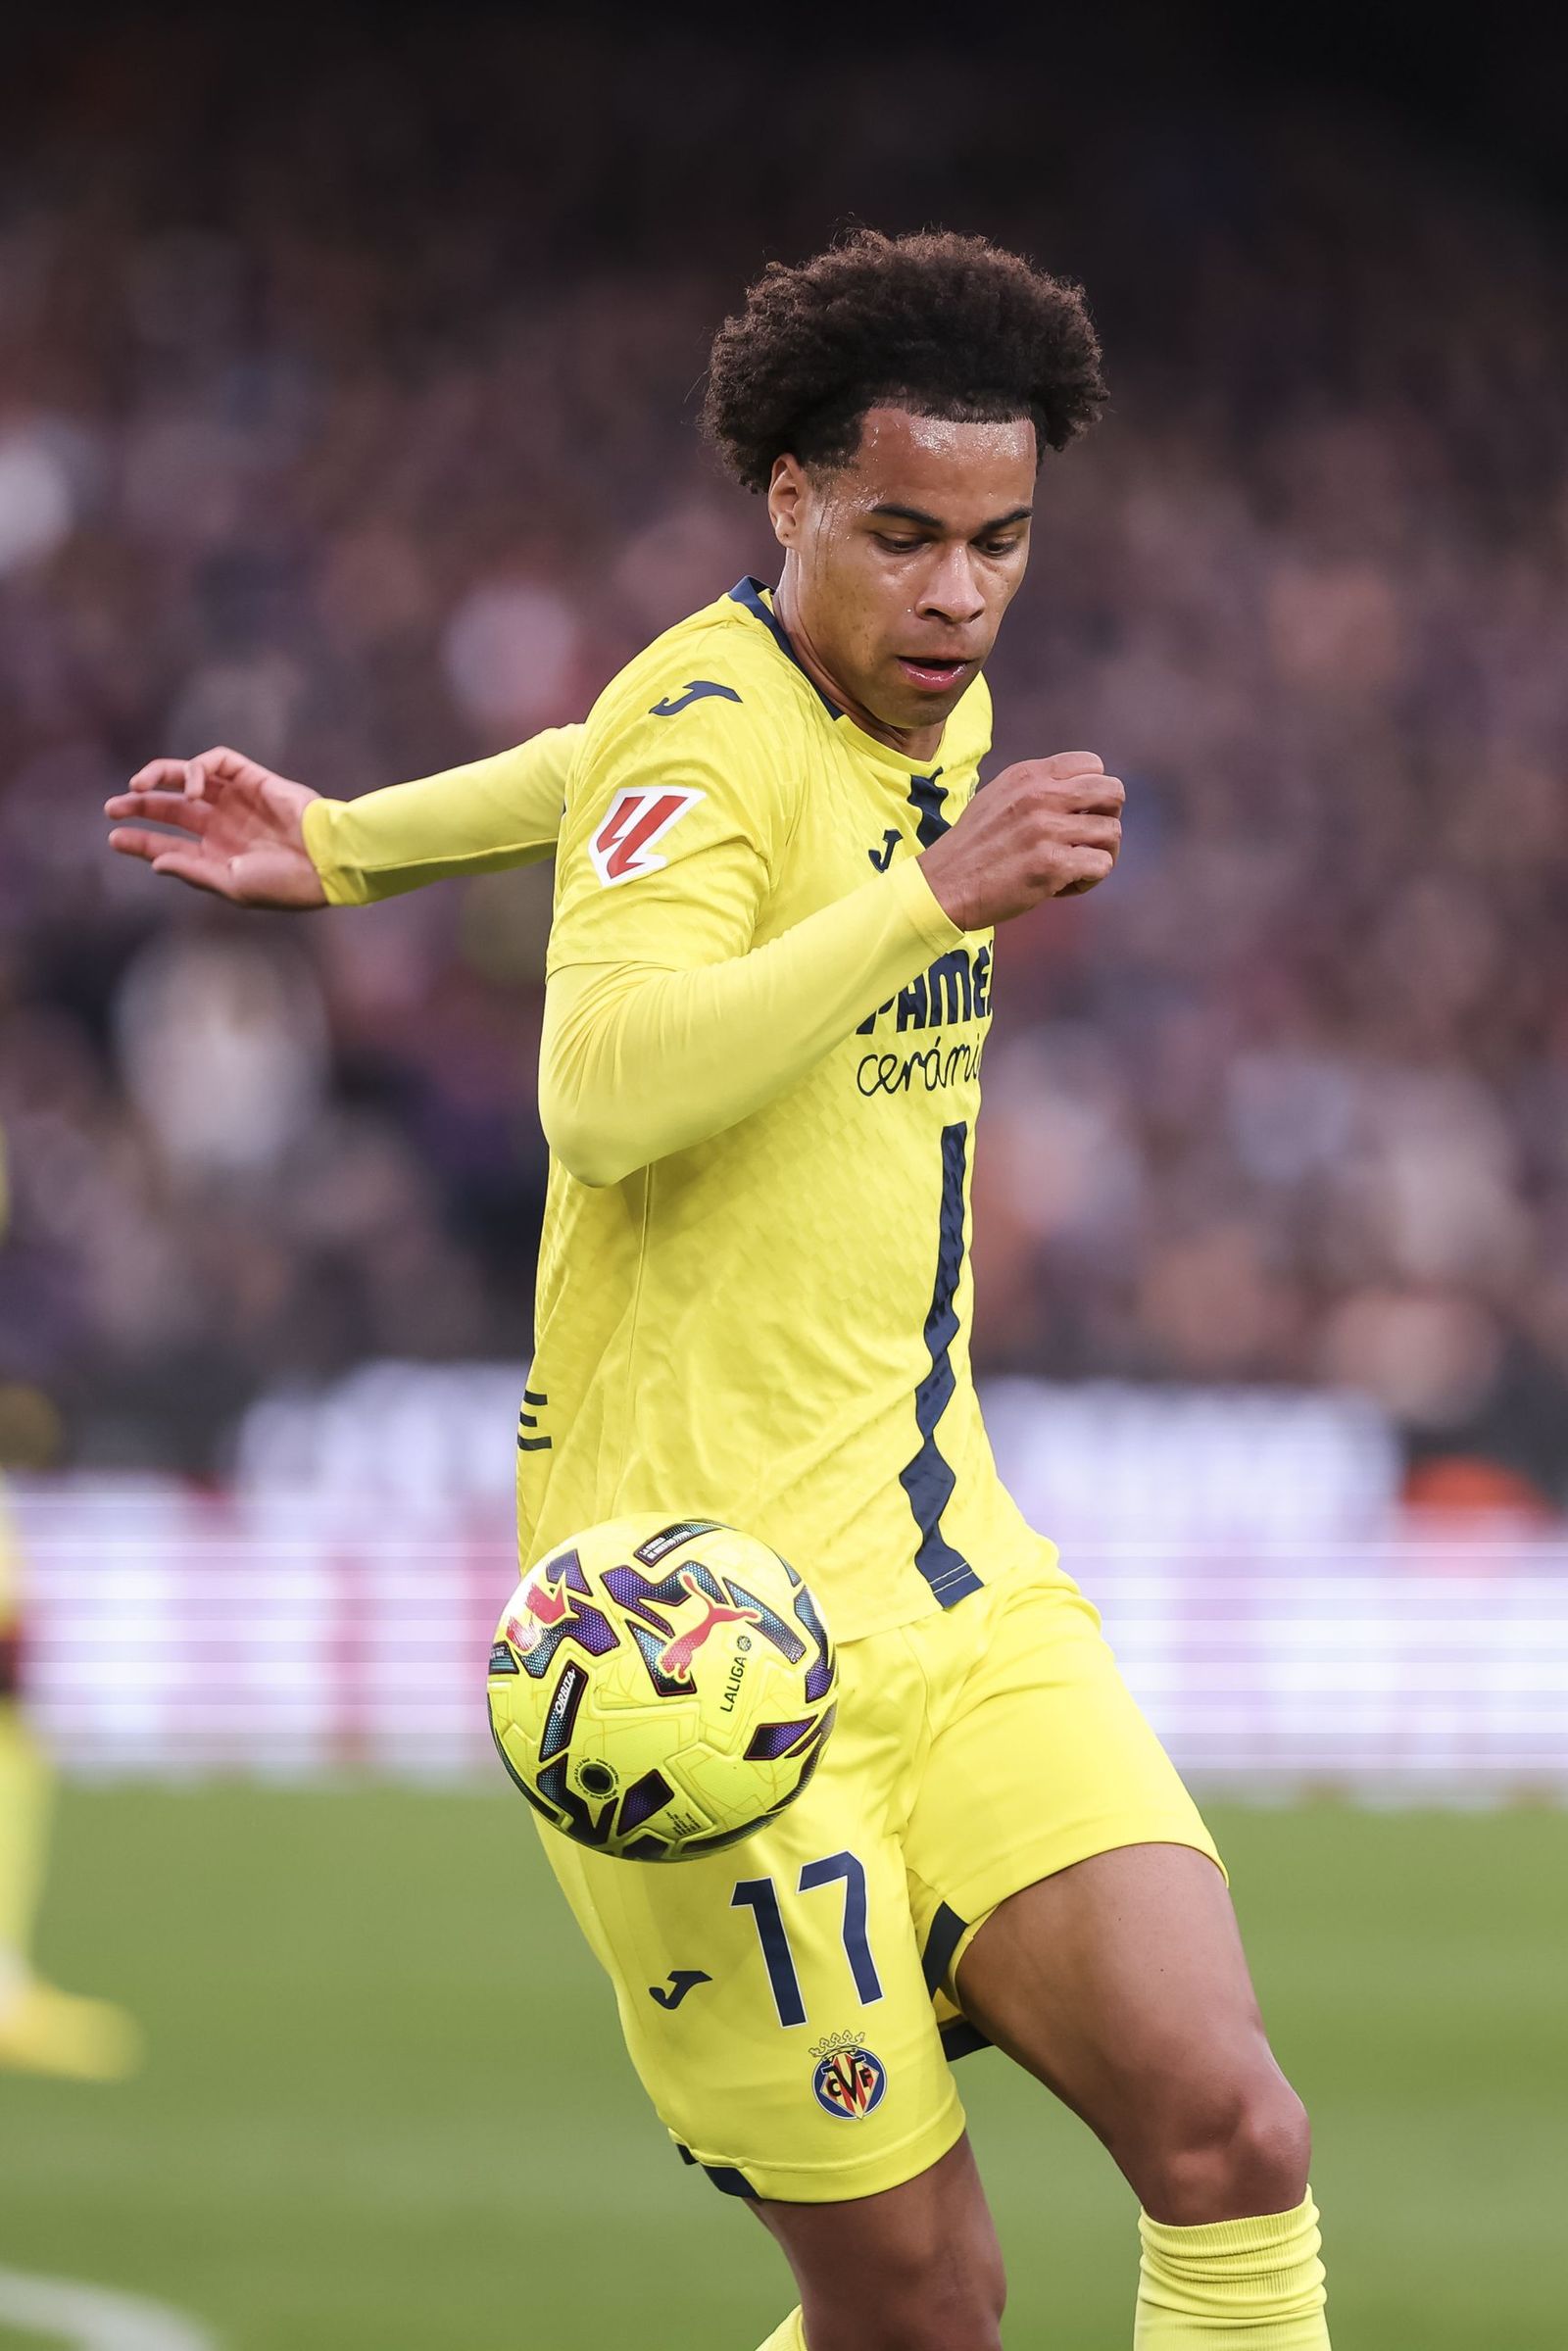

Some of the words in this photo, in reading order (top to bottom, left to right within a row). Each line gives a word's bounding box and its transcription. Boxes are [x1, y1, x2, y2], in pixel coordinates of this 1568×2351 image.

[856, 939, 994, 1035] AME
[555, 1668, 576, 1719] ORBITA
[719, 1656, 747, 1713] LALIGA
[729, 1849, 884, 2029] 17
